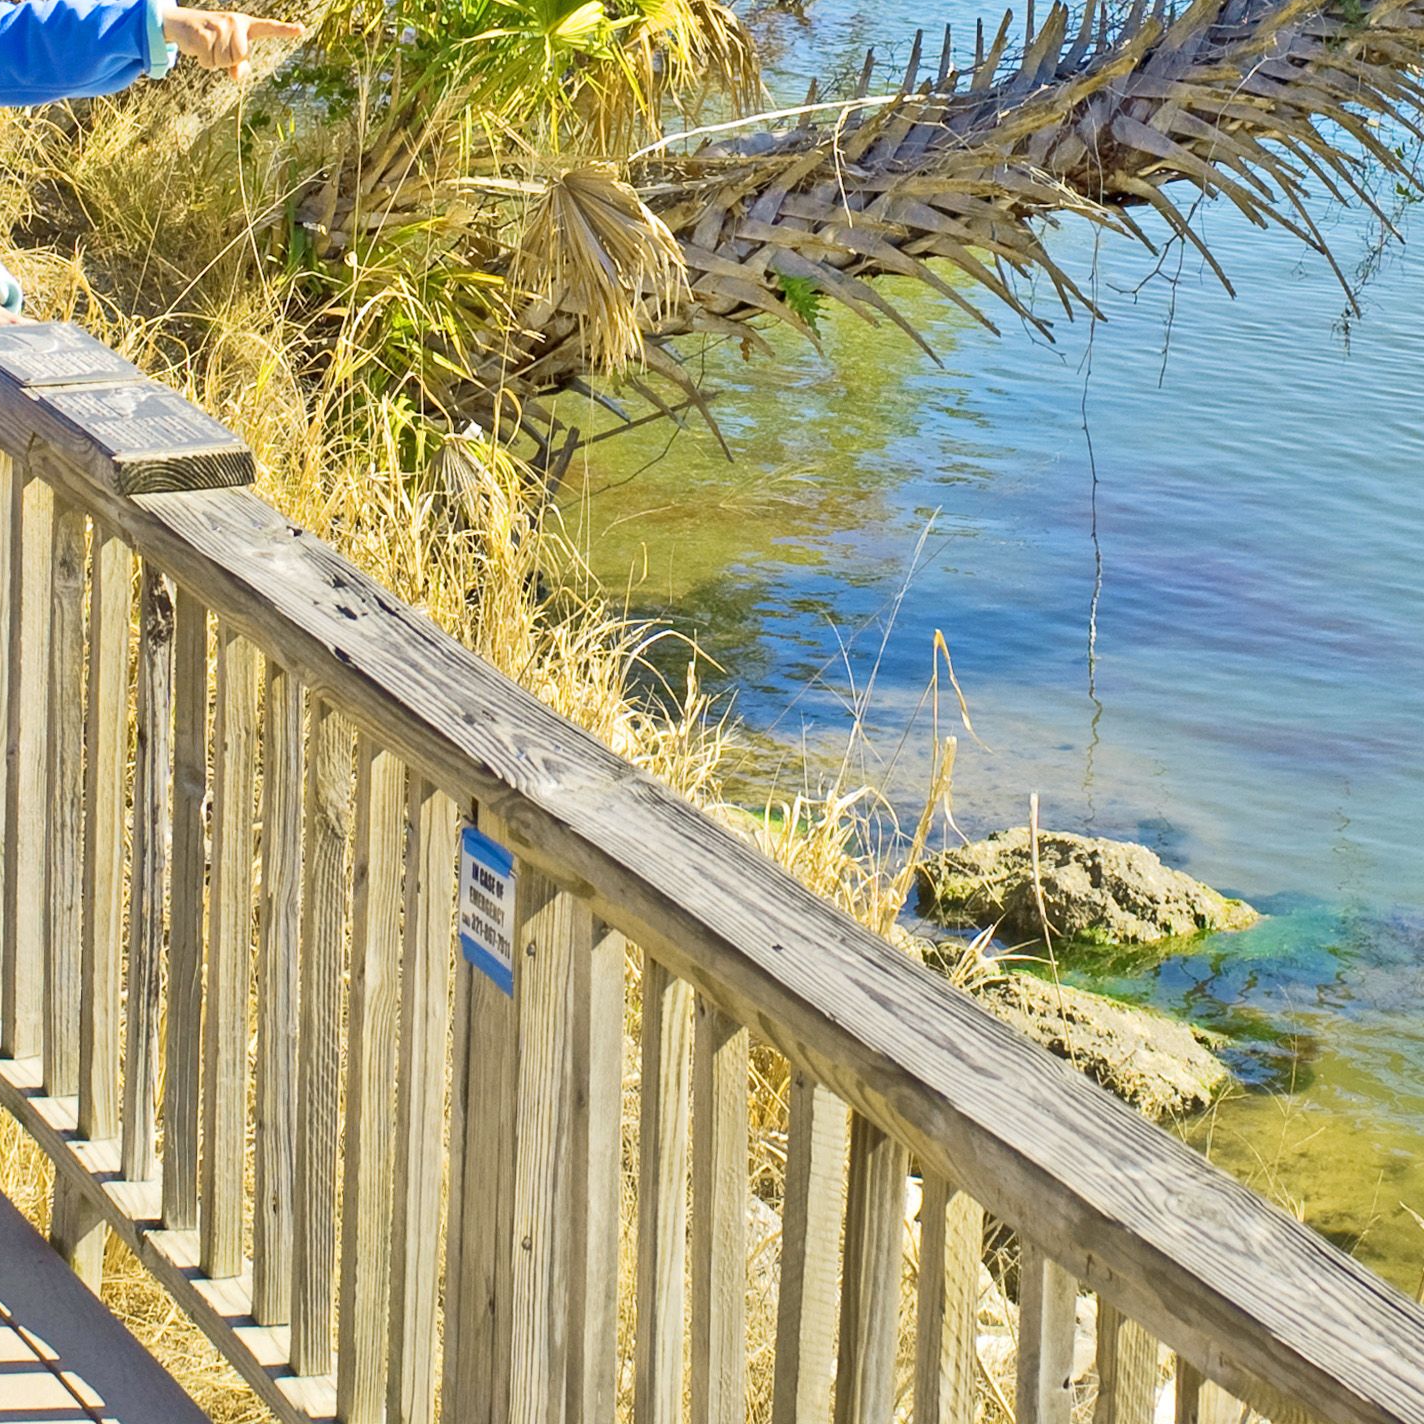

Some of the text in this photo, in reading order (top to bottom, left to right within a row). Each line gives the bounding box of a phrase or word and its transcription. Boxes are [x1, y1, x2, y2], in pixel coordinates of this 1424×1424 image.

[472, 861, 504, 901] IN CASE OF
[469, 885, 504, 928] EMERGENCY
